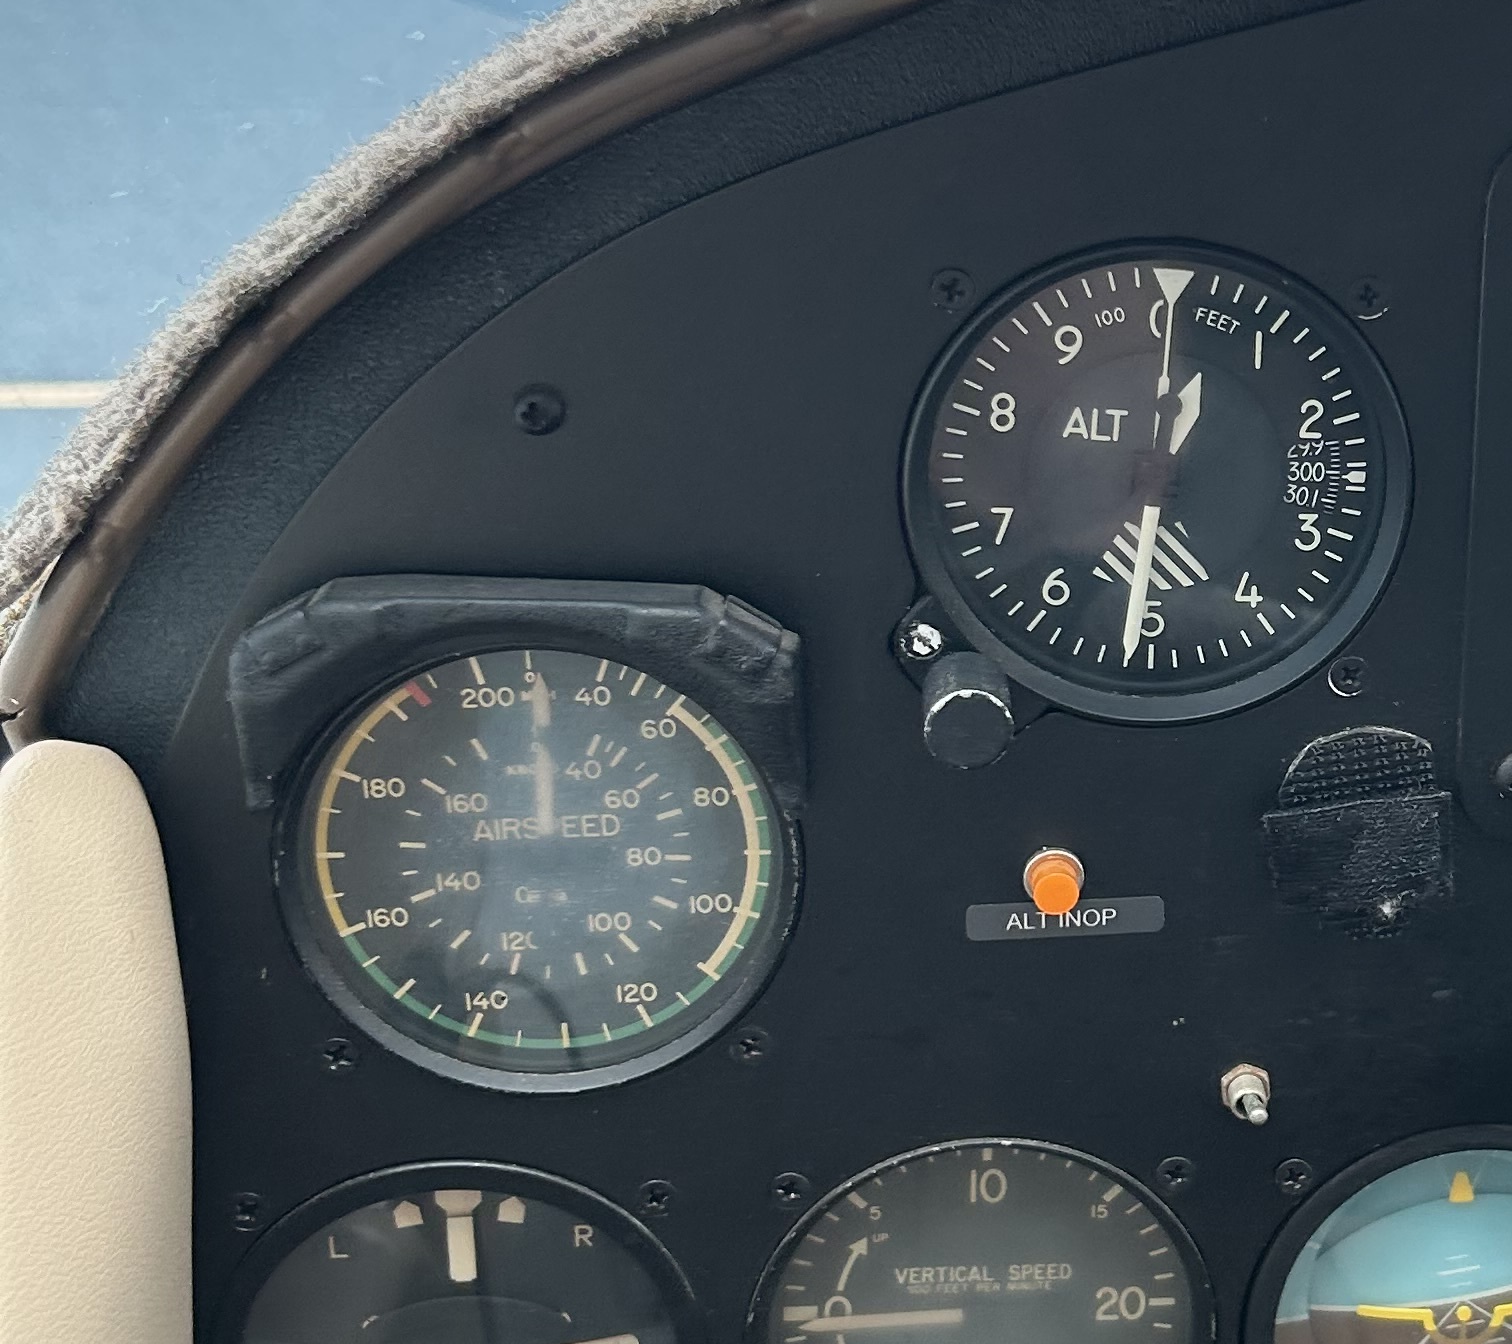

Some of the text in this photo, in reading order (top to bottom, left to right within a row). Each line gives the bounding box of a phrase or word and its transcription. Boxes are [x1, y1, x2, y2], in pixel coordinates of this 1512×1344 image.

[1094, 307, 1126, 328] 100
[1194, 307, 1241, 335] FEET
[1054, 325, 1083, 365] 9
[989, 392, 1016, 432] 8
[1299, 399, 1324, 439] 2
[1062, 407, 1128, 442] ALT
[1283, 483, 1319, 508] 30.1
[990, 507, 1014, 544] 7
[1293, 513, 1321, 552] 3
[1042, 568, 1070, 606] 6
[1234, 571, 1263, 607] 4
[1140, 601, 1165, 638] 5
[461, 687, 515, 708] 200
[575, 686, 610, 707] 40
[641, 718, 676, 739] 60
[565, 760, 601, 780] 40
[362, 777, 405, 799] 180
[604, 789, 640, 809] 60
[693, 787, 729, 806] 80
[445, 792, 488, 814] 160
[473, 814, 621, 841] AIRSEED
[626, 847, 662, 866] 80
[436, 870, 480, 892] 140
[689, 893, 733, 914] 100
[366, 908, 408, 928] 160
[588, 912, 632, 933] 100
[1006, 908, 1117, 931] ALT INOP
[465, 990, 508, 1011] 140
[616, 982, 657, 1003] 120
[969, 1168, 1008, 1204] 10
[869, 1206, 881, 1220] 5
[1090, 1205, 1108, 1219] 15
[574, 1224, 594, 1247] R
[872, 1233, 889, 1242] UP
[329, 1236, 348, 1259] L
[895, 1263, 1072, 1284] VERTICAL SPEED
[1095, 1286, 1147, 1322] 20
